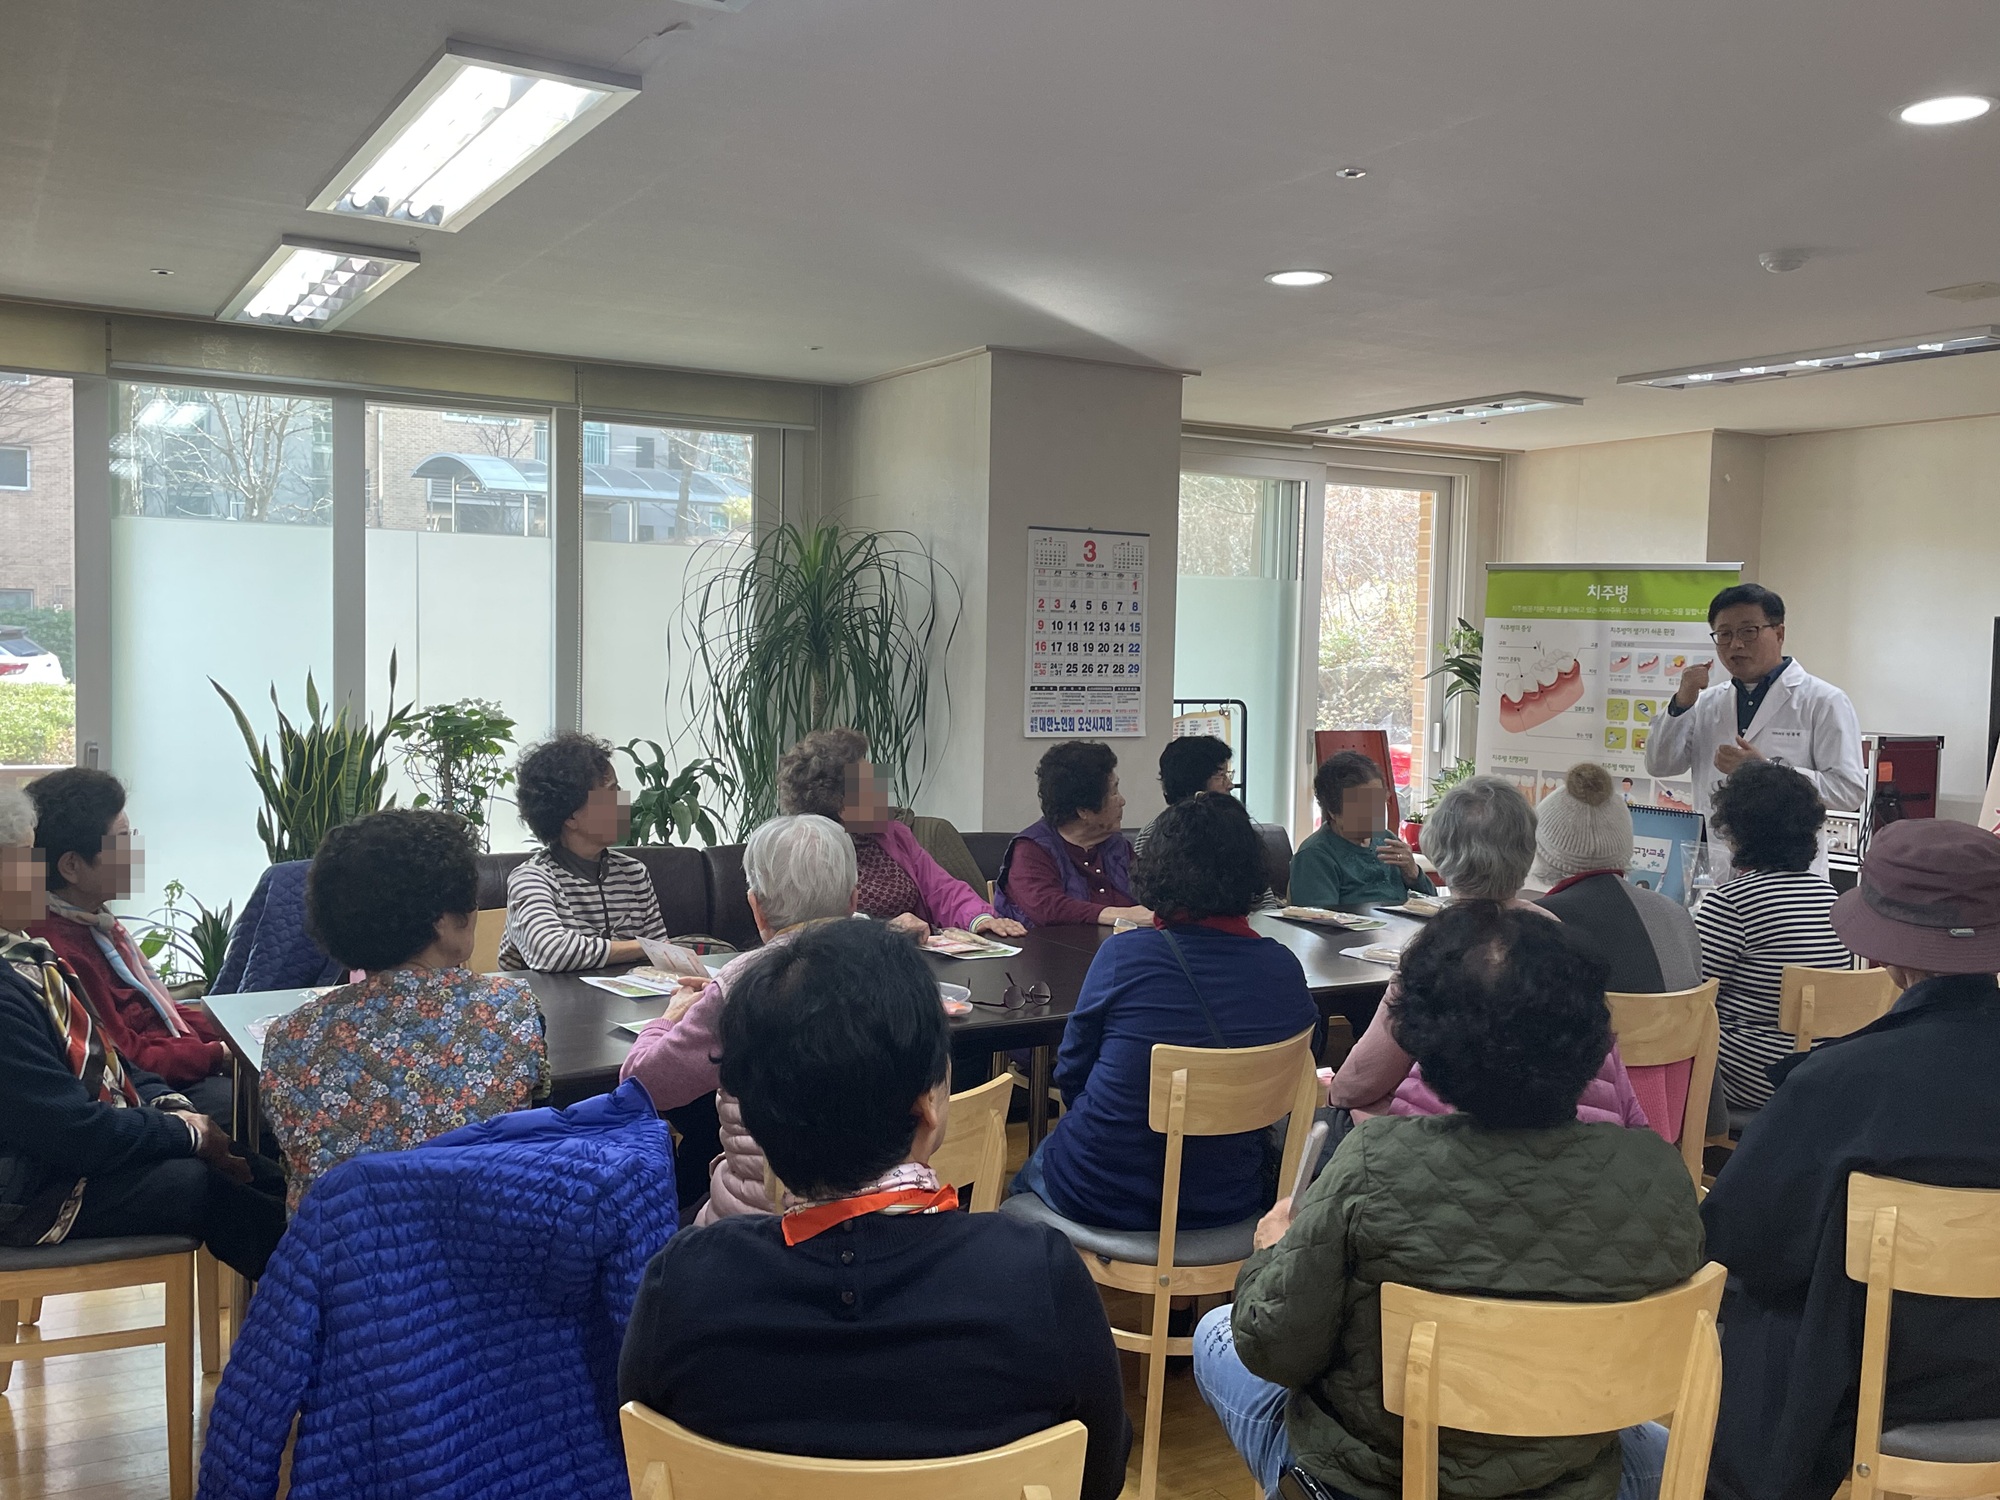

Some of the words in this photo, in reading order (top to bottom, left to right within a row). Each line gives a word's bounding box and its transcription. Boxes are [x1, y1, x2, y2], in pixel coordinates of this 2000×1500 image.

[1083, 540, 1097, 562] 3
[1133, 581, 1138, 591] 1
[1587, 584, 1629, 604] 치주병
[1038, 599, 1045, 609] 2
[1054, 599, 1061, 609] 3
[1070, 600, 1076, 610] 4
[1086, 600, 1092, 610] 5
[1101, 601, 1108, 611] 6
[1117, 601, 1123, 611] 7
[1132, 602, 1138, 612] 8
[1037, 620, 1044, 630] 9
[1051, 620, 1063, 631] 10
[1067, 621, 1078, 631] 11
[1083, 621, 1095, 632] 12
[1099, 622, 1110, 632] 13
[1114, 622, 1125, 632] 14
[1129, 622, 1141, 632] 15
[1633, 627, 1650, 636] 생기기
[1663, 628, 1675, 636] 환경
[1035, 641, 1047, 651] 16
[1051, 642, 1062, 652] 17
[1067, 642, 1079, 652] 18
[1083, 643, 1094, 653] 19
[1098, 643, 1110, 653] 20
[1113, 643, 1124, 653] 21
[1128, 643, 1140, 653] 22
[1066, 663, 1078, 673] 25
[1082, 664, 1094, 673] 26
[1097, 664, 1109, 673] 27
[1112, 664, 1124, 674] 28
[1128, 664, 1140, 673] 29
[1039, 716, 1075, 732] 대한노인회
[1077, 716, 1113, 732] 오산시지회
[1633, 847, 1666, 859] 구강교육
